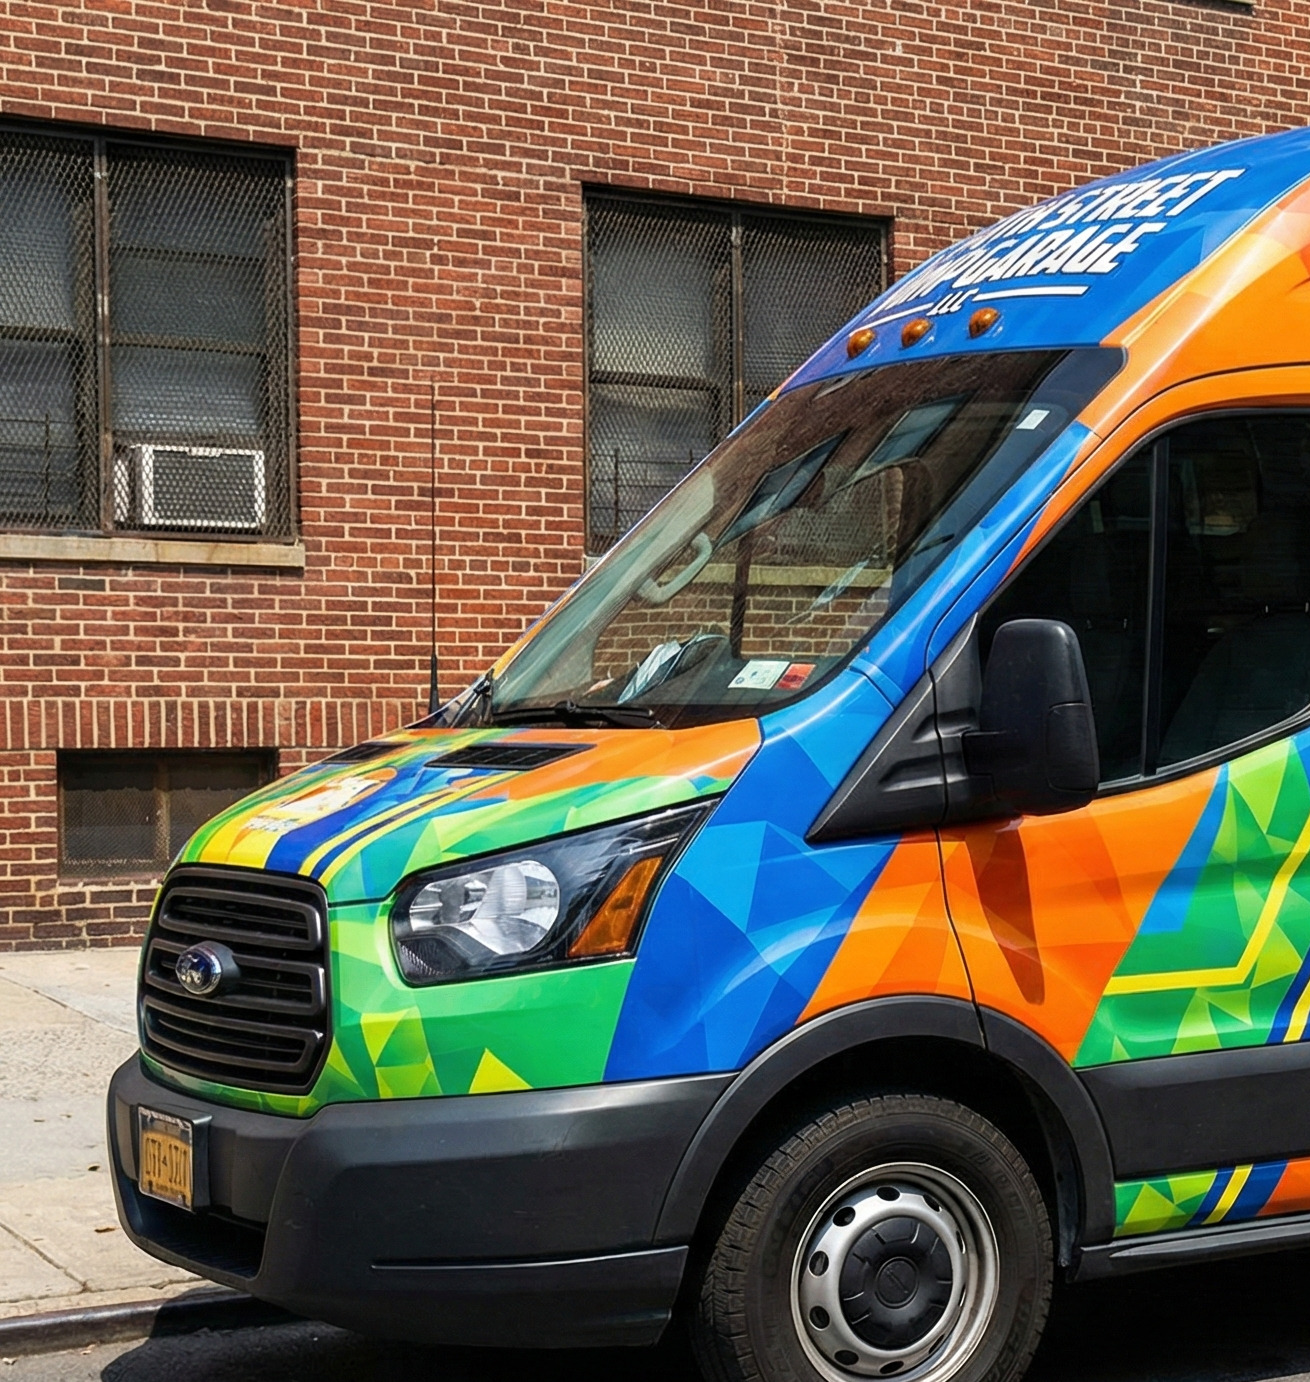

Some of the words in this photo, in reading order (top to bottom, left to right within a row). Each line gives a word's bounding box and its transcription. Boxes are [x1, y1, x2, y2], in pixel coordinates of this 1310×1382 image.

[1036, 168, 1246, 230] STREET
[951, 222, 1168, 289] GARAGE
[926, 288, 980, 316] LLC
